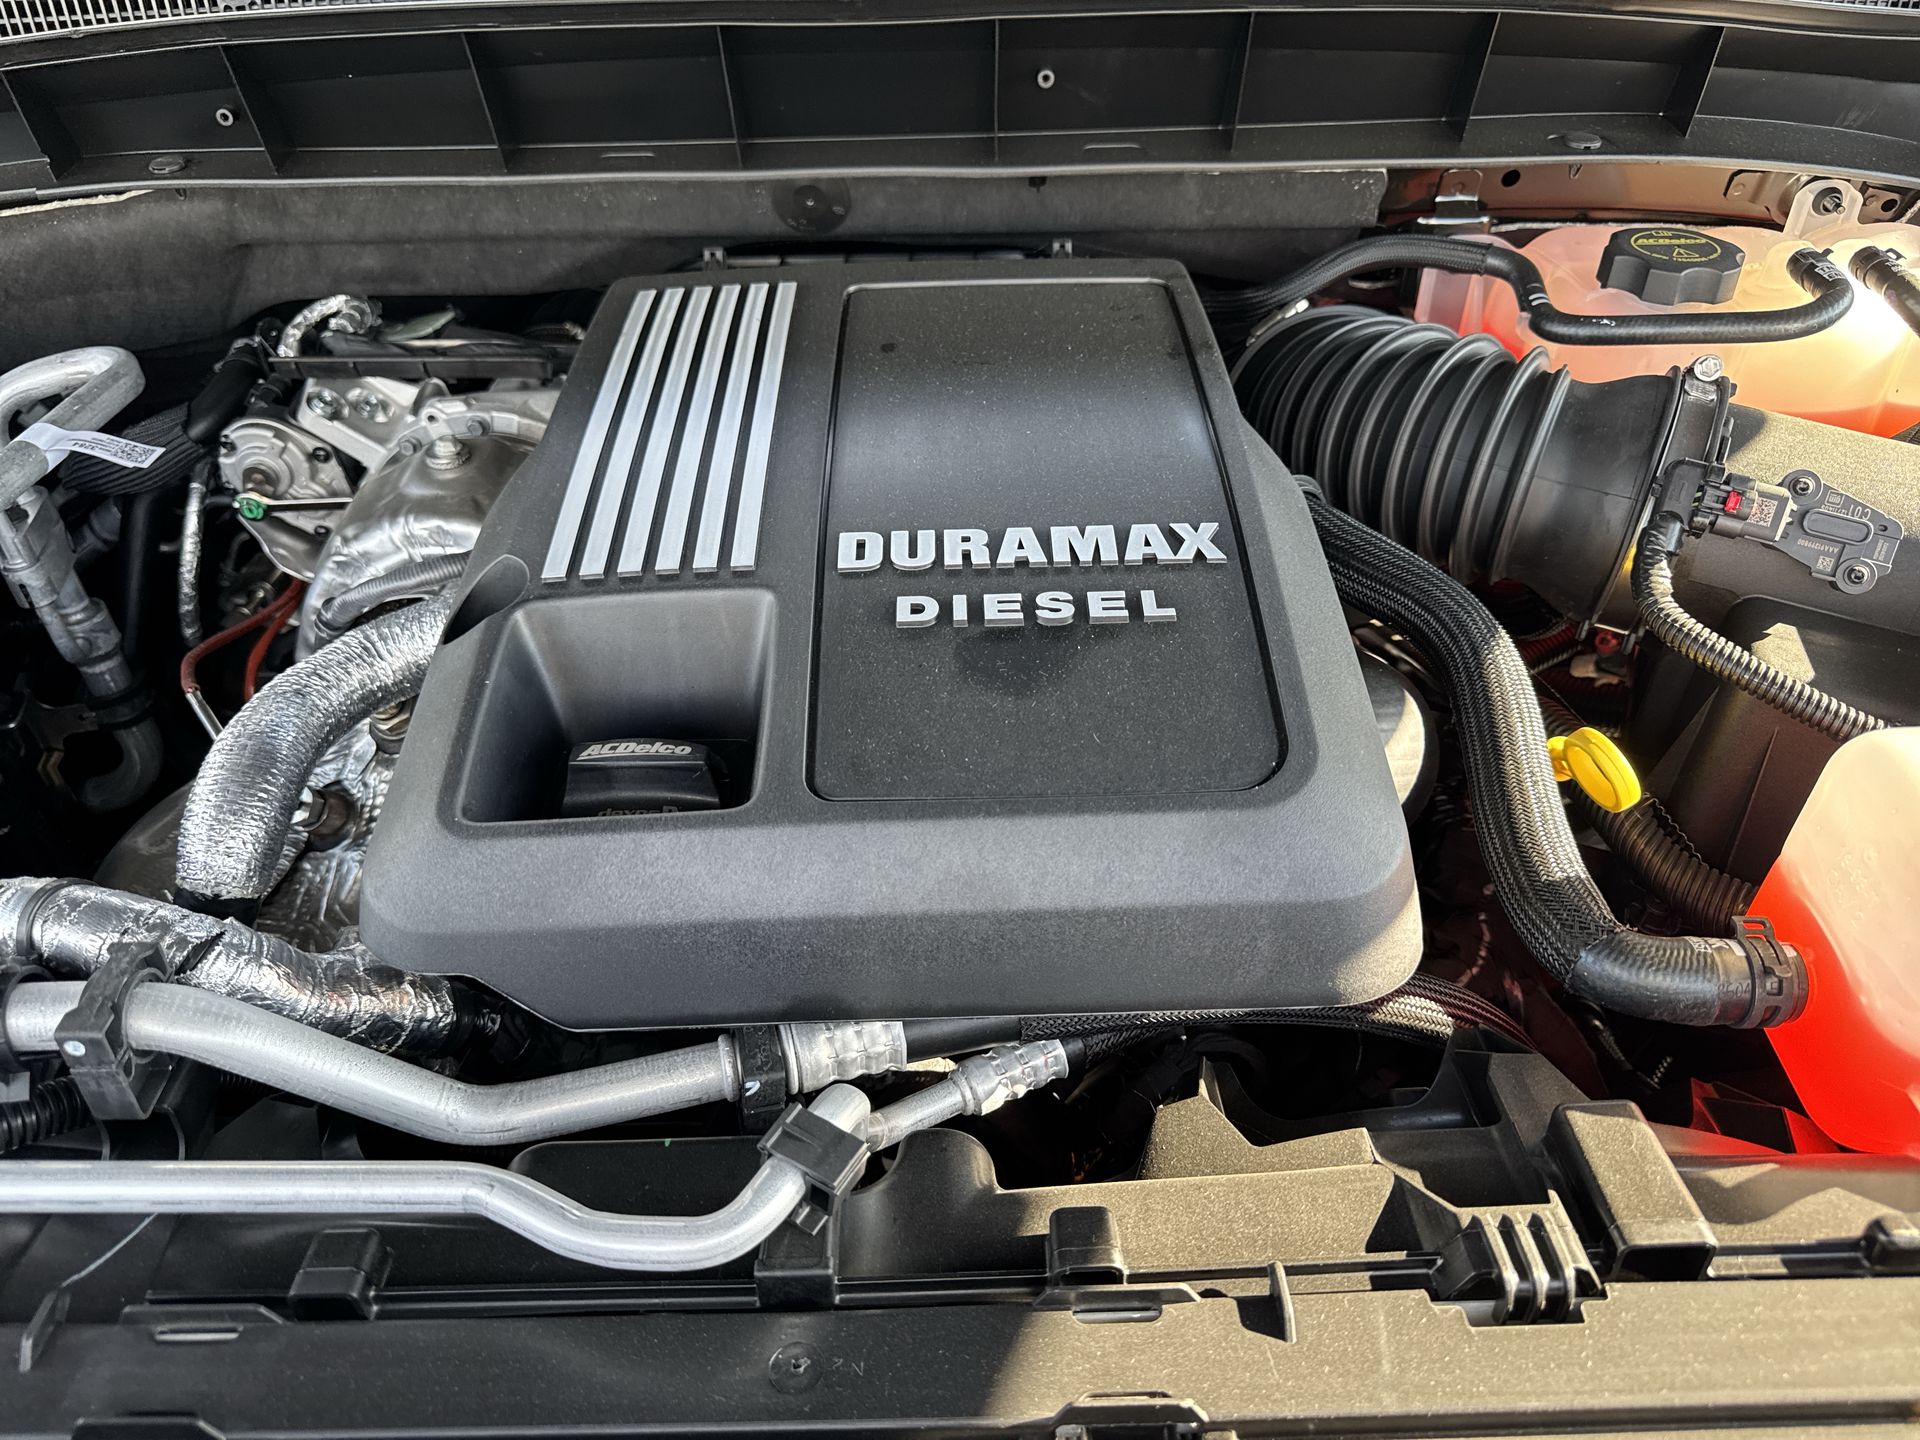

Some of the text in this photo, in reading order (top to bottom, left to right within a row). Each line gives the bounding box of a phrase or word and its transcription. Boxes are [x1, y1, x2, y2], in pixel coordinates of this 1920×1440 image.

[837, 522, 1228, 573] DURAMAX
[896, 590, 1177, 628] DIESEL
[577, 741, 693, 760] ACDelco
